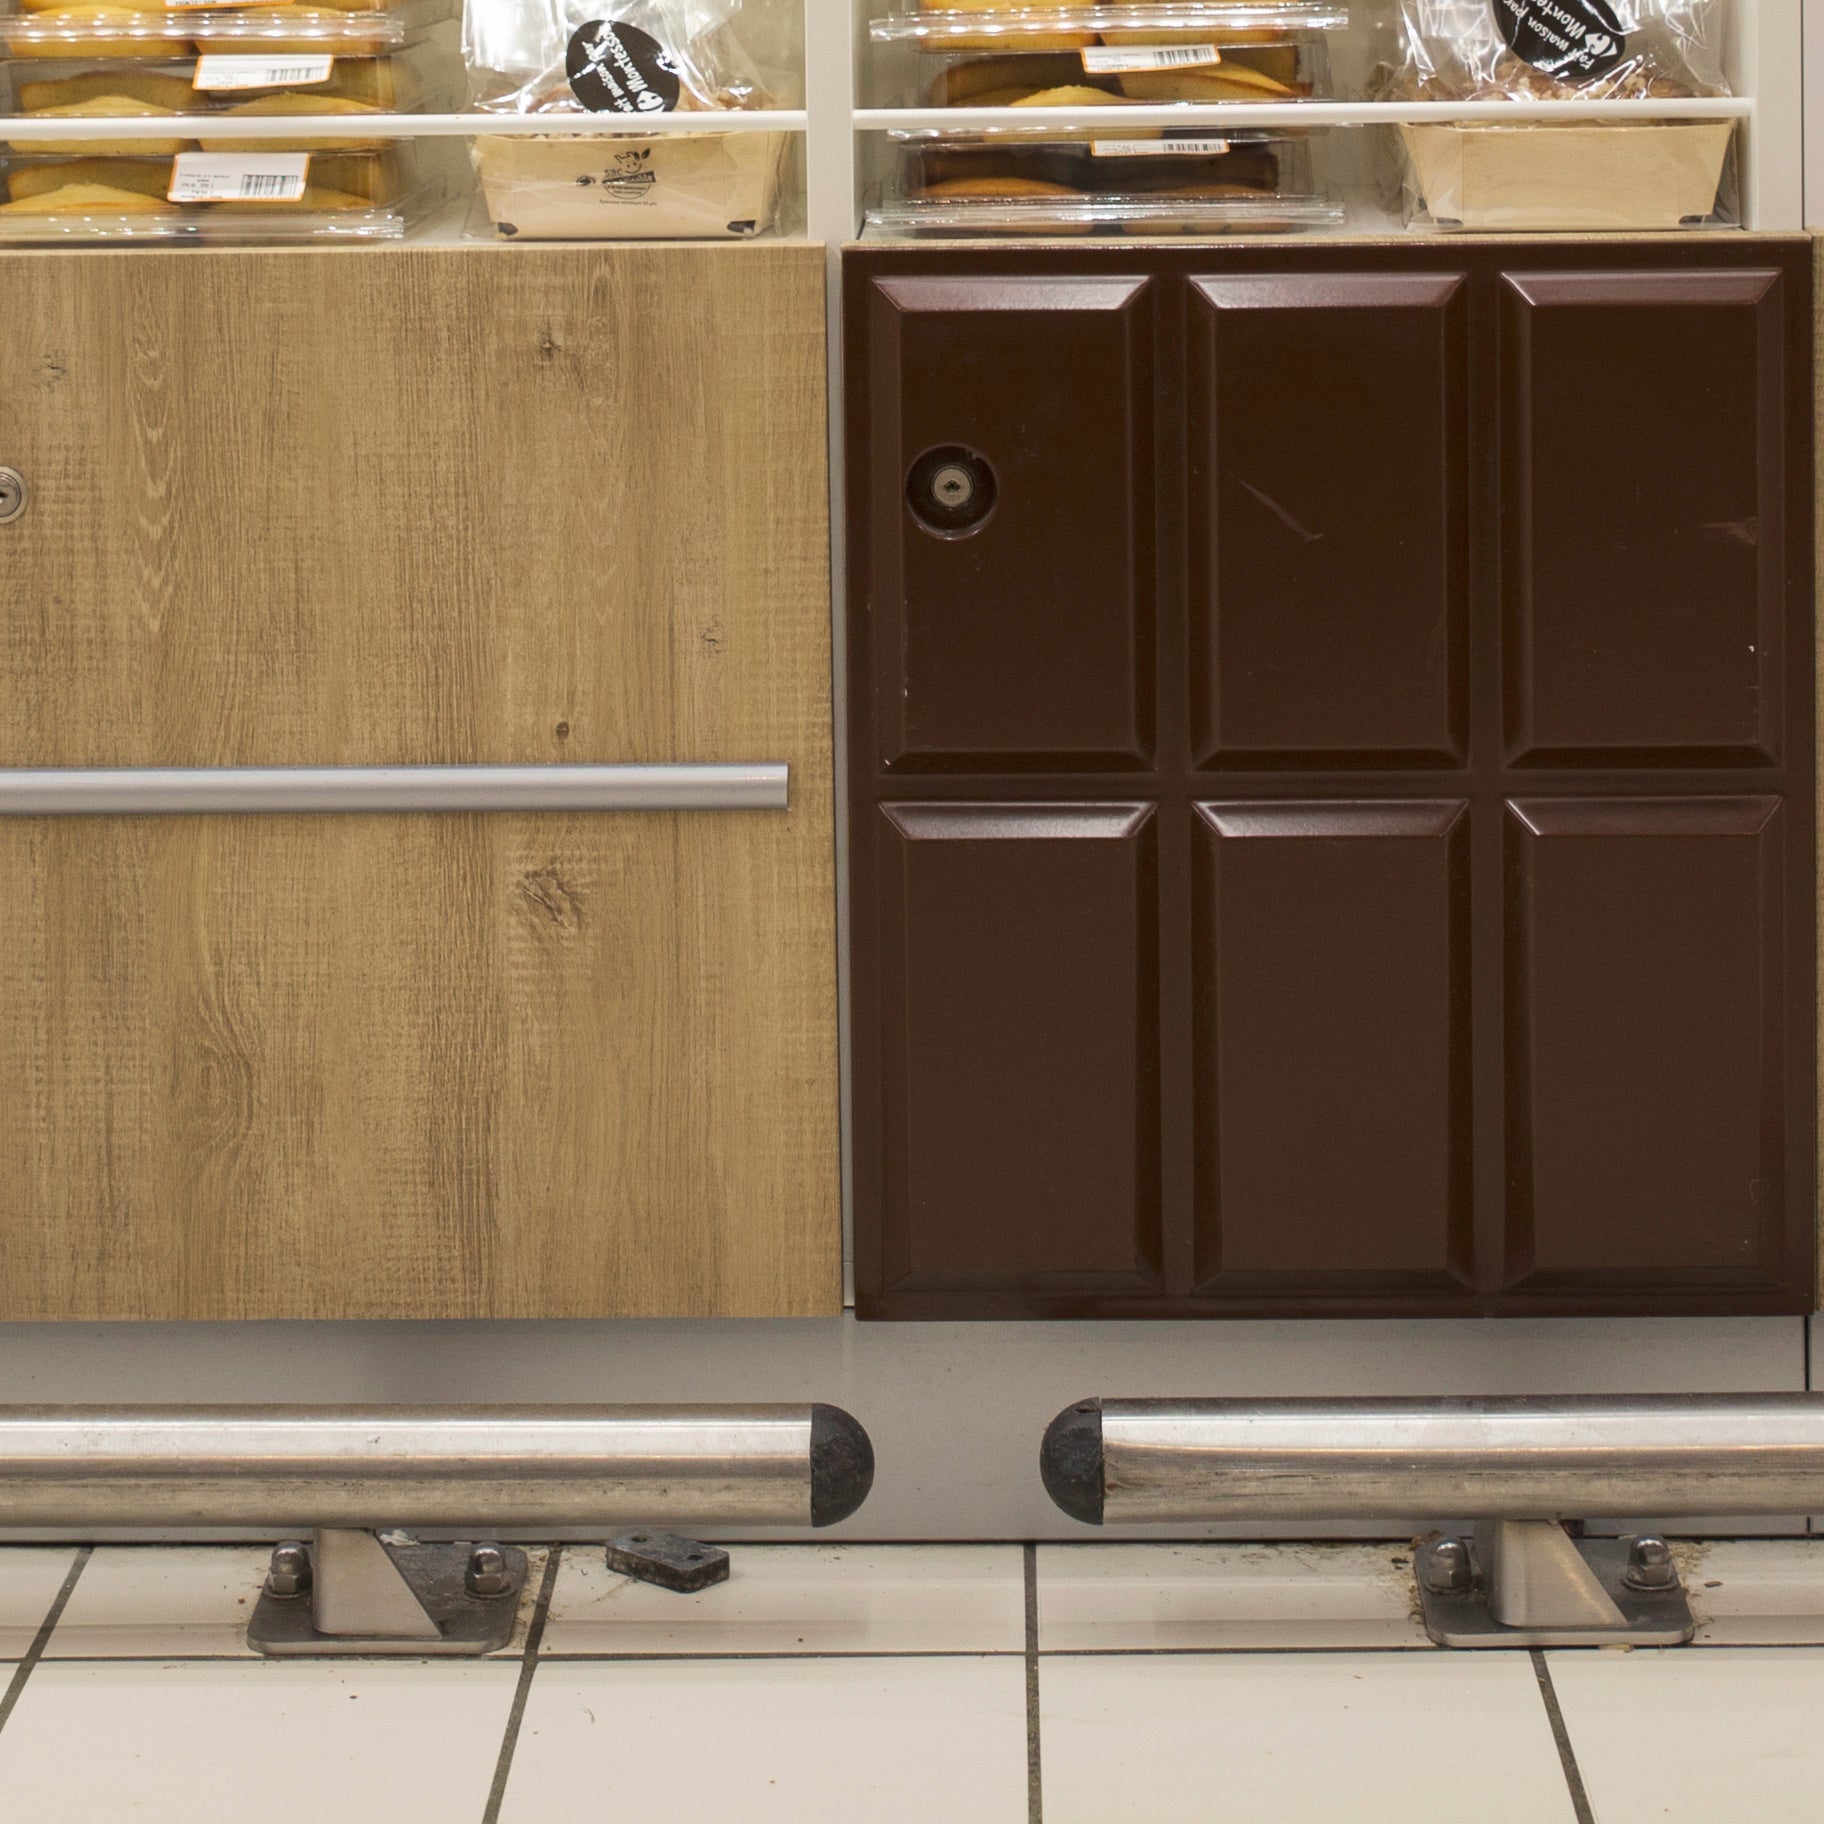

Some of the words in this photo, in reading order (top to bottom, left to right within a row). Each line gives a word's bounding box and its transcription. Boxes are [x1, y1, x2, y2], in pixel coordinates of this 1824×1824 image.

[1526, 15, 1570, 52] maison
[596, 22, 649, 94] Montesso
[596, 62, 624, 99] maison
[613, 96, 634, 113] ait
